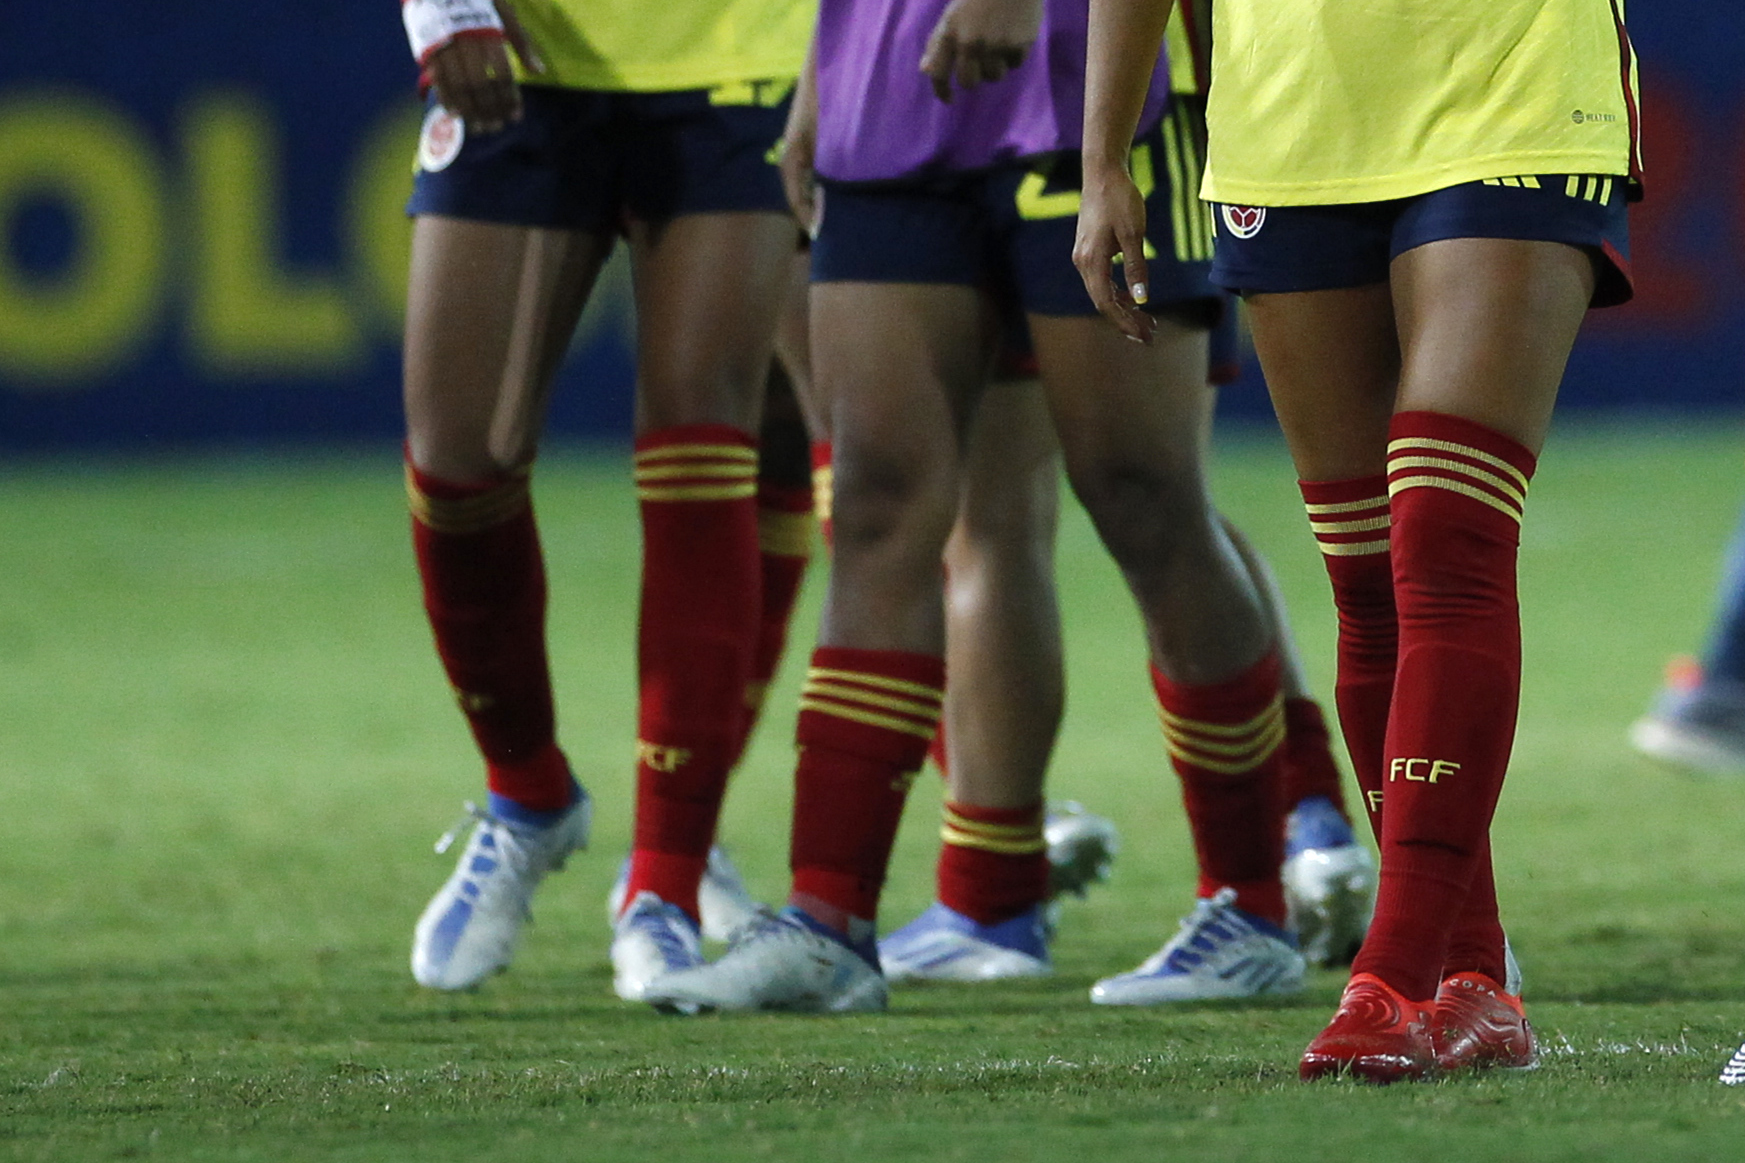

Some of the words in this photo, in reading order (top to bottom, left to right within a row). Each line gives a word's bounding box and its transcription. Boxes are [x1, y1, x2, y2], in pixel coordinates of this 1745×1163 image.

[0, 86, 412, 384] OL
[1390, 758, 1461, 784] FCF
[1449, 978, 1496, 998] COPA
